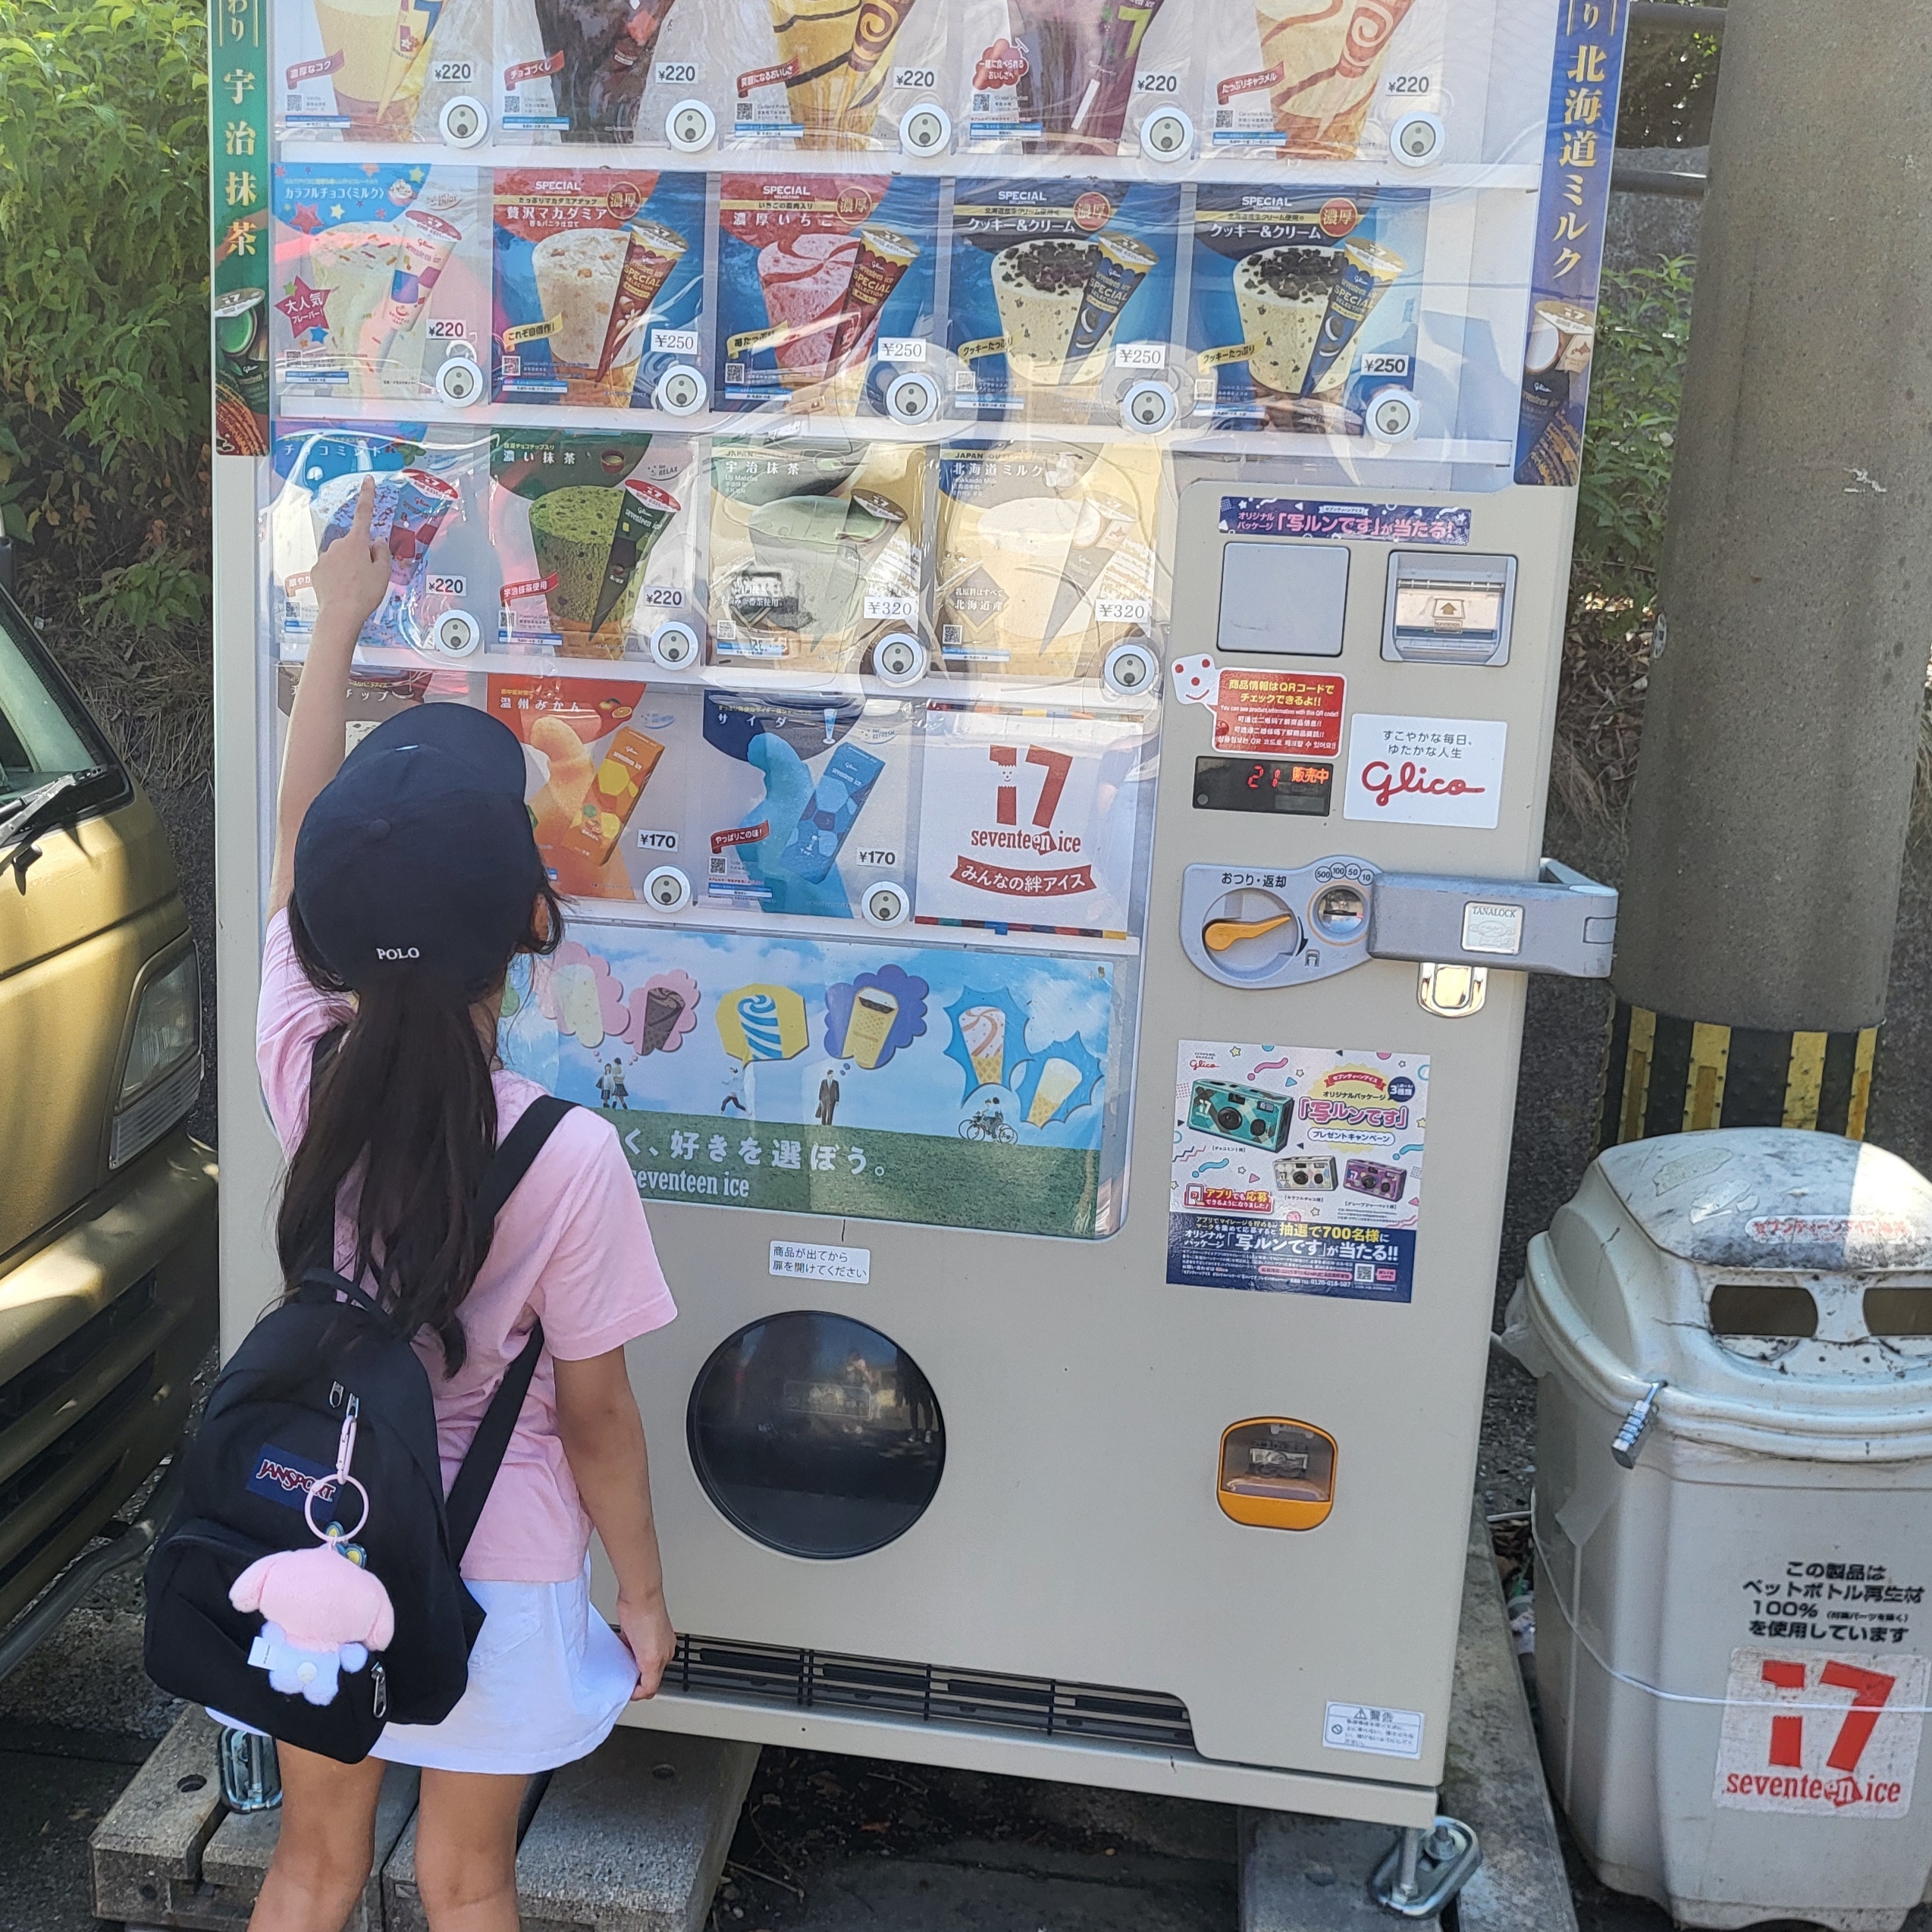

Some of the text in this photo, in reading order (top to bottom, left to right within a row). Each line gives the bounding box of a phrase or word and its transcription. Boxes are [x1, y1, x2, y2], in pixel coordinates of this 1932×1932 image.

[434, 64, 472, 80] ¥220
[510, 60, 552, 80] チョコづくし
[658, 65, 696, 82] ¥220
[896, 70, 935, 87] ¥220
[1137, 75, 1178, 93] ¥220
[1222, 73, 1278, 94] たっぷりキャラメル
[1388, 76, 1430, 93] ¥220
[224, 68, 258, 256] 宇治抹茶
[1552, 45, 1607, 280] 北海道ミルク
[285, 187, 384, 200] カラフルチョコ〈ミルク〉
[535, 181, 582, 191] SPECIAL
[763, 186, 811, 196] SPECIAL
[518, 196, 597, 205] たっぷりマカダミアナッツ
[610, 192, 637, 209] 濃厚
[998, 190, 1047, 201] SPECIAL
[1242, 196, 1292, 208] SPECIAL
[507, 205, 607, 221] 贅沢マカダミア
[840, 196, 867, 213] 濃厚
[733, 212, 834, 227] 濃厚いちご
[968, 217, 1076, 234] クッキー&クリーム
[1322, 209, 1353, 226] 濃厚
[1209, 223, 1322, 240] クッキー&クリーム
[623, 264, 662, 287] SPECIAL
[852, 269, 892, 293] SPECIAL
[1089, 277, 1128, 302] SPECIAL
[1335, 284, 1374, 309] SPECIAL
[285, 292, 324, 314] 大人気
[291, 308, 325, 325] フレーバー!
[428, 321, 465, 337] ¥220
[507, 321, 556, 341] これぞ自信作!
[654, 333, 695, 350] ¥250
[881, 343, 922, 358] ¥250
[1118, 348, 1162, 365] ¥250
[1202, 344, 1256, 364] クッキーたっぷり
[1363, 357, 1407, 374] ¥250
[503, 449, 576, 465] 濃い抹茶
[658, 466, 678, 476] RELAX
[725, 460, 799, 475] 宇治抹茶
[952, 462, 1043, 477] 北海道ミルク
[1237, 512, 1275, 522] オリジナル
[1237, 521, 1274, 531] パッケージ
[428, 578, 463, 594] ¥220
[503, 580, 547, 597] 宇治抹茶使用
[954, 587, 1005, 597] 乳原料はすべて
[646, 589, 682, 606] ¥220
[954, 599, 1005, 612] 北海道産
[867, 601, 912, 616] ¥320
[1099, 604, 1145, 618] ¥320
[1228, 679, 1335, 695] 商品情報はQRコードで
[500, 696, 579, 712] 温州みかん
[1240, 694, 1322, 707] チェックできるよ!!
[1382, 729, 1473, 746] すこやかな毎日、
[1388, 745, 1462, 759] ゆたかな人生
[1291, 765, 1330, 785] 販売中
[1362, 761, 1485, 807] Glico
[640, 833, 676, 848] ¥170
[715, 829, 763, 845] やっぱりこの味!
[971, 830, 1081, 853] seventeen ice
[858, 850, 896, 865] ¥170
[961, 864, 1086, 893] みんなの絆アイス
[1221, 872, 1287, 889] おつり・返却
[1316, 866, 1372, 882] 500 100 50 10
[1472, 906, 1516, 918] TANALOCK
[376, 947, 419, 960] POLO
[1189, 1060, 1220, 1071] Glico
[1322, 1090, 1386, 1101] オリジナルパッケージ
[1298, 1096, 1410, 1128] 「写ルンです」
[1313, 1131, 1391, 1143] プレゼントキャンペーン
[624, 1128, 886, 1177] く、好きを選ぼう。
[723, 1171, 750, 1197] ice
[1184, 1229, 1225, 1240] オリジナル
[1279, 1222, 1390, 1243] 抽選で700名様に
[1184, 1239, 1225, 1249] パッケージ
[773, 1245, 849, 1263] 商品が出てから
[772, 1260, 867, 1279] 扉を開けてください
[1786, 1560, 1887, 1582] この製品は
[1752, 1599, 1818, 1619] 100%
[1748, 1620, 1910, 1644] を使用しています
[1726, 1773, 1902, 1805] seventeen ice
